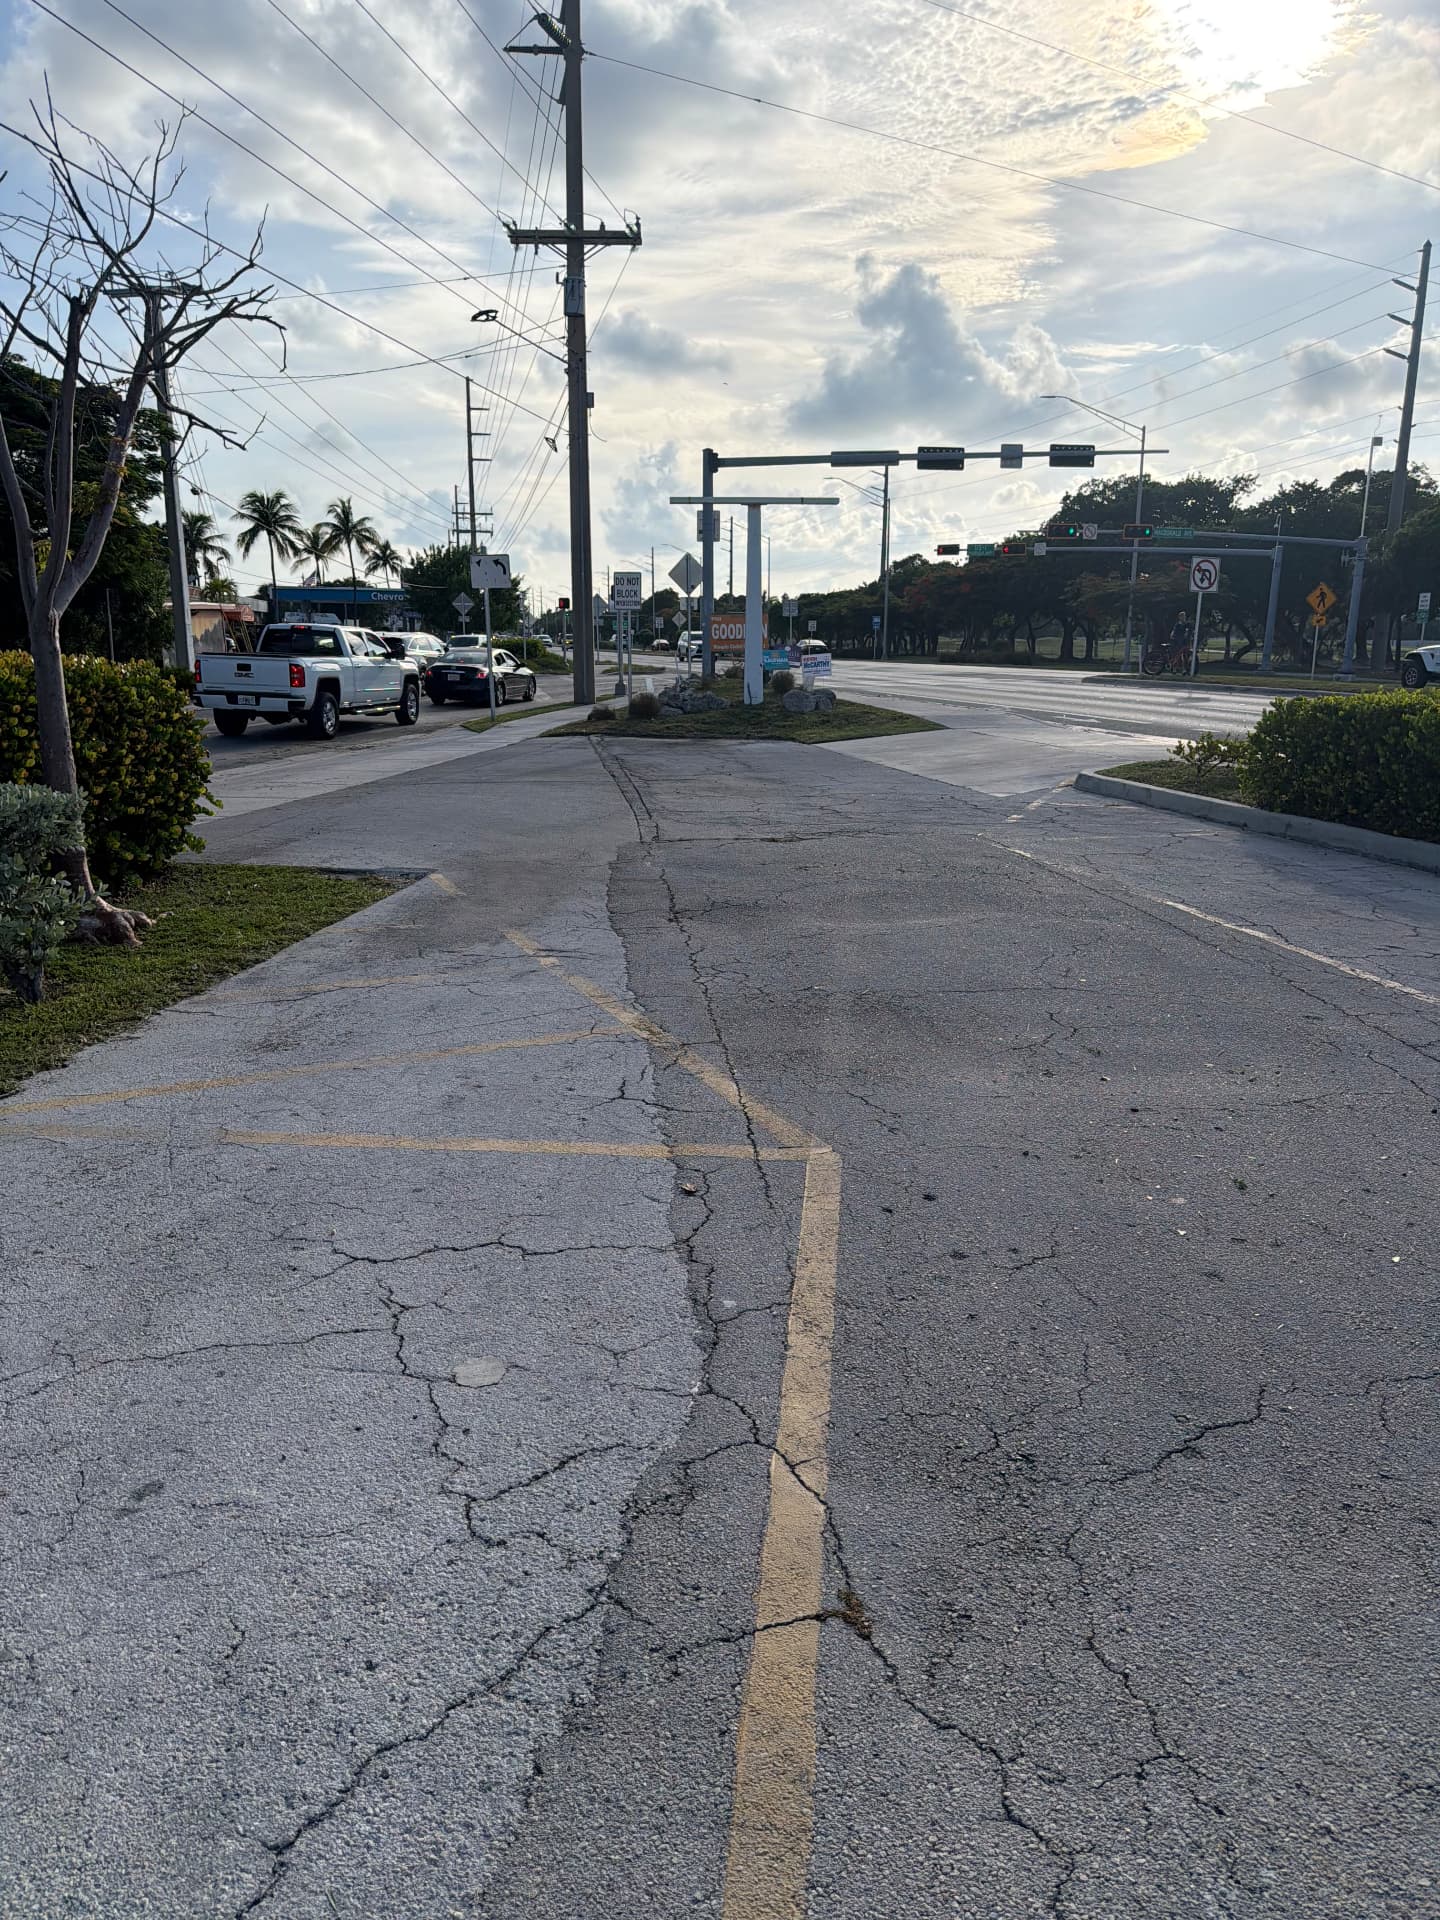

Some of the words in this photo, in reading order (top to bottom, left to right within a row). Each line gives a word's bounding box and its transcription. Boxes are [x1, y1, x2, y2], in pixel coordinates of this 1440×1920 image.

[616, 577, 625, 586] DO
[627, 577, 640, 586] NOT
[617, 589, 638, 598] BLOCK
[712, 623, 768, 640] GOODN
